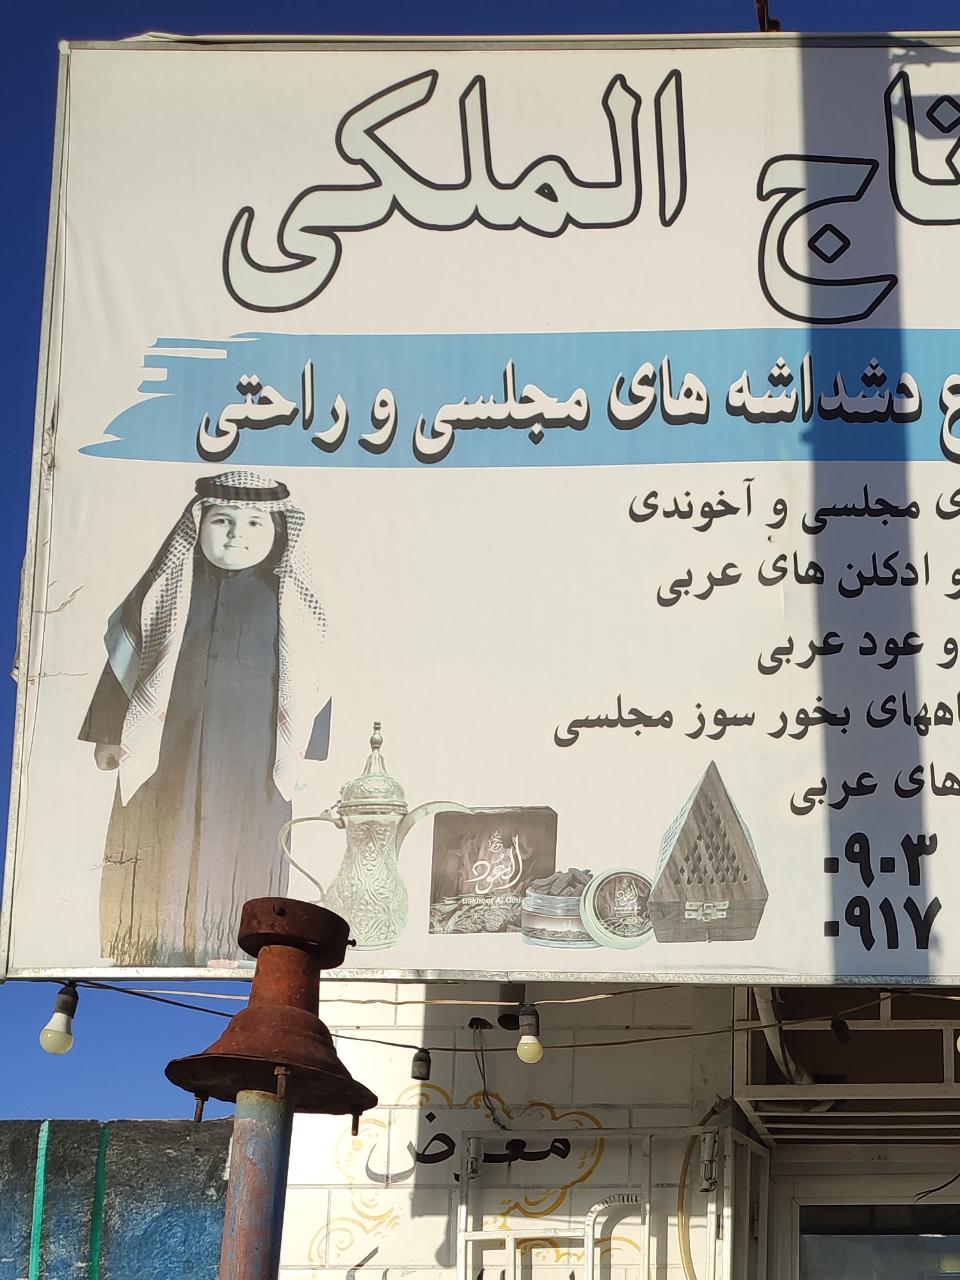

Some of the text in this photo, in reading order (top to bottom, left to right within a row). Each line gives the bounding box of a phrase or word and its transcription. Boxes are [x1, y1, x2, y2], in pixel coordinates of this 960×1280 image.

[412, 357, 591, 464] مجلسی
[607, 354, 709, 430] های
[725, 350, 923, 424] دشداشه
[358, 388, 398, 453] و
[628, 477, 755, 530] آخوندی
[765, 497, 787, 530] و
[801, 483, 920, 535] مجلسی
[656, 561, 742, 607] عربی
[757, 551, 825, 587] های
[837, 550, 930, 598] ادکلن
[757, 631, 844, 675] عربی
[858, 631, 924, 671] عود
[937, 637, 959, 670] و
[554, 695, 674, 748] مجلسی
[685, 702, 756, 741] سوز
[767, 694, 851, 740] بخور
[790, 771, 878, 815] عربی
[823, 832, 938, 888] ۰۹۰۳
[823, 895, 942, 951] ۰۹۱۷
